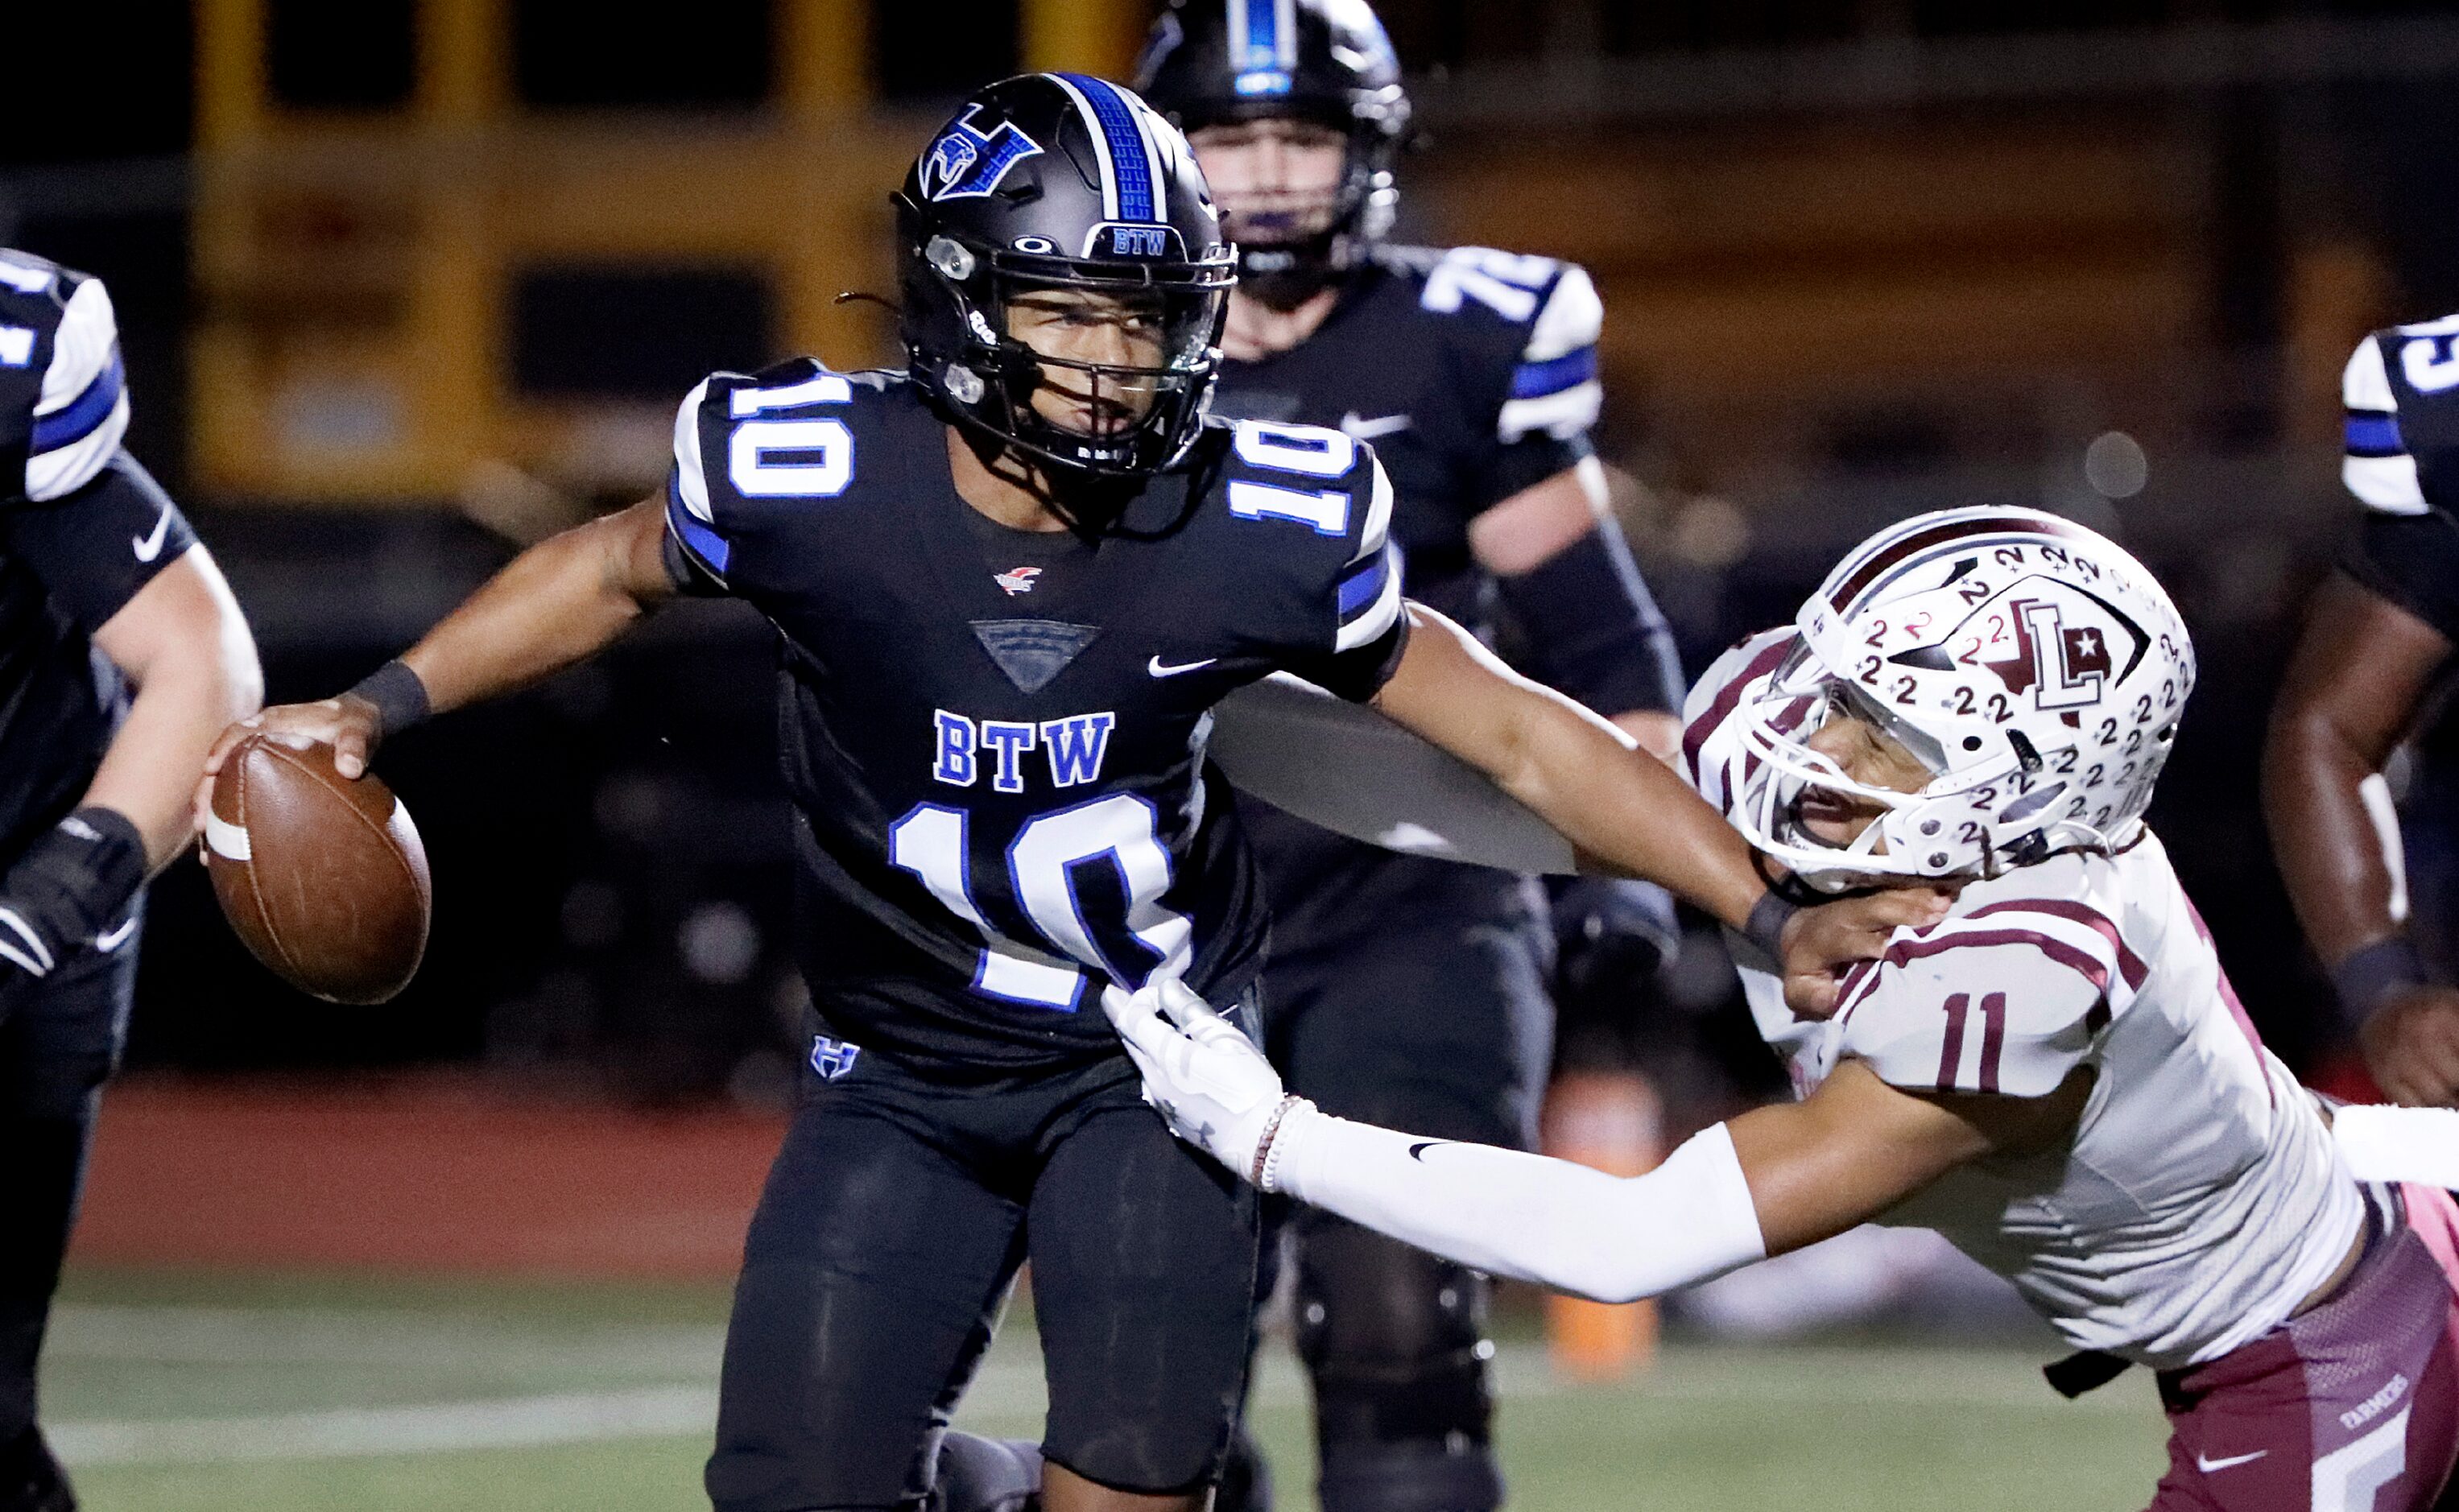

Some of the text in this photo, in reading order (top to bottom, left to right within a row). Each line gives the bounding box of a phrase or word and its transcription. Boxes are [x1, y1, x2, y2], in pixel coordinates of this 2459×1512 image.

[1113, 227, 1166, 256] BTW
[728, 371, 855, 499] 10
[1225, 419, 1358, 537] 10
[1994, 547, 2024, 565] 2
[2040, 546, 2070, 564] 2
[1958, 581, 1990, 605] 2
[1866, 620, 1887, 648] 2
[1904, 611, 1932, 639] 2
[1988, 615, 2009, 642] 2
[1958, 637, 1982, 666] 2
[1861, 655, 1882, 685] 2
[1896, 675, 1917, 704] 2
[1955, 686, 1977, 715] 2
[1988, 693, 2014, 724] 2
[2138, 694, 2152, 724] 2
[2100, 717, 2118, 746] 2
[933, 708, 1115, 793] BTW
[2056, 749, 2079, 773] 2
[2086, 763, 2105, 788] 2
[1971, 787, 1997, 810] 2
[1958, 821, 1981, 845] 2
[888, 792, 1194, 1012] 10
[1936, 991, 2006, 1093] 11
